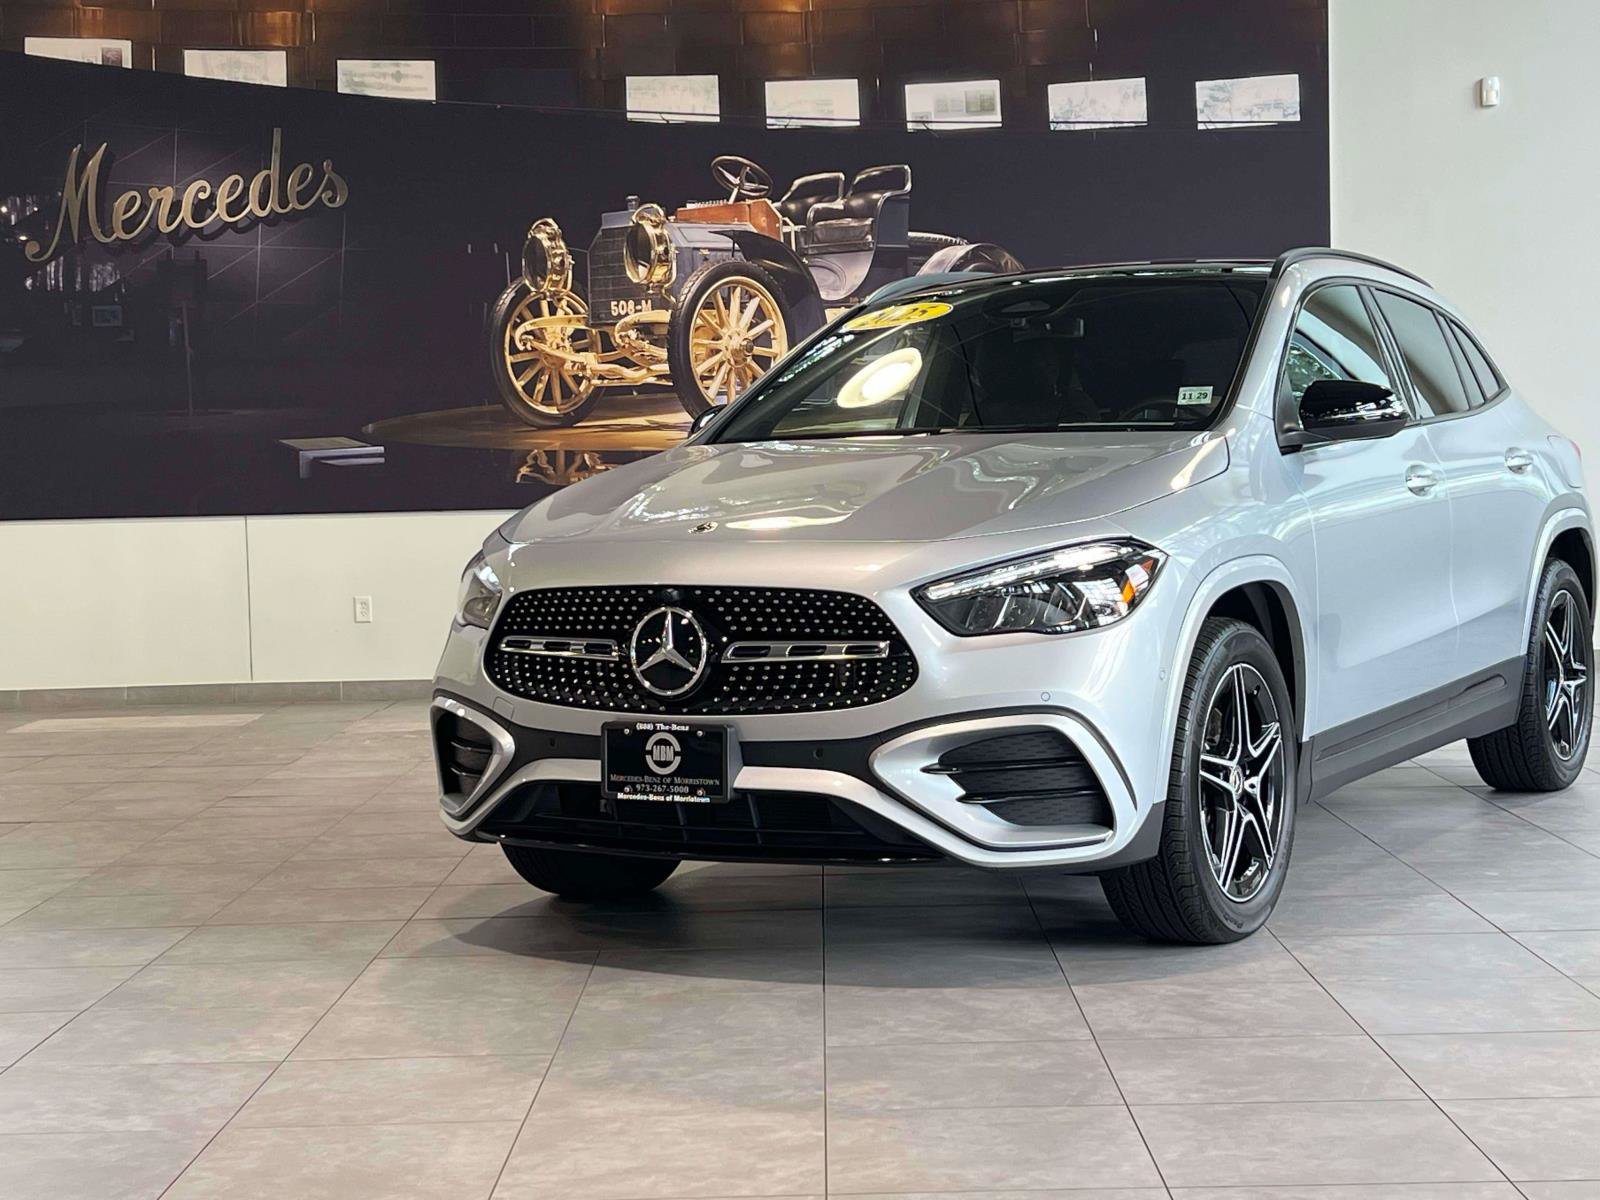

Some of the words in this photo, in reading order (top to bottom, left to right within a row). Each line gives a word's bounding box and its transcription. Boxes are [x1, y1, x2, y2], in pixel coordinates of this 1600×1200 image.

[25, 127, 348, 262] Mercedes
[610, 300, 652, 317] 508-M
[652, 745, 674, 761] MBM
[636, 784, 689, 793] 973-267-5000
